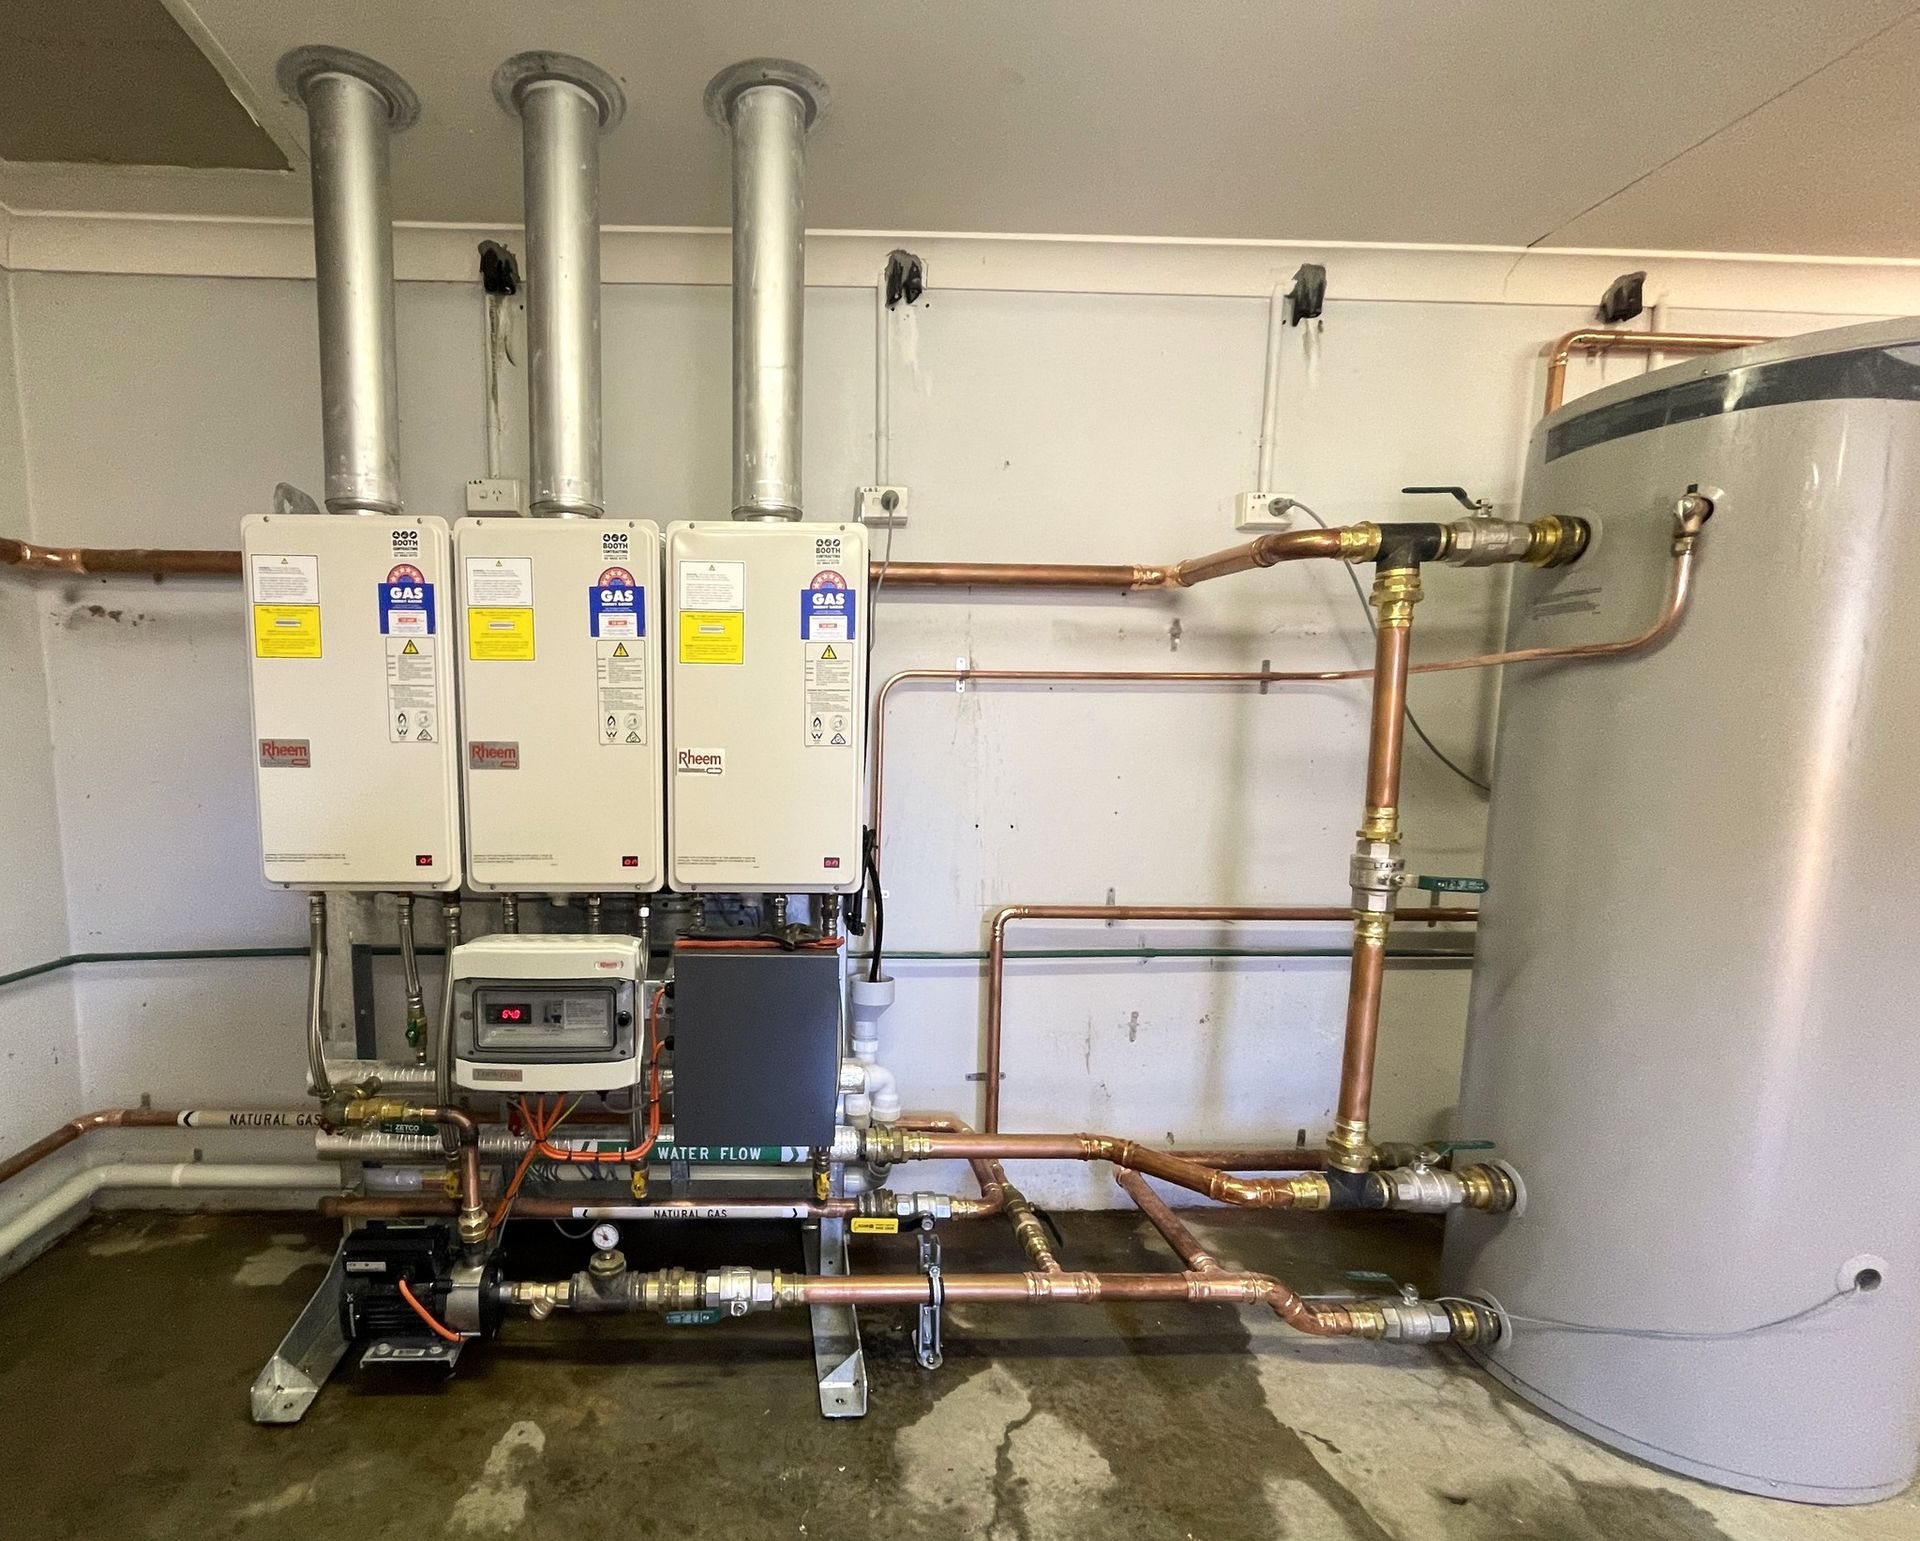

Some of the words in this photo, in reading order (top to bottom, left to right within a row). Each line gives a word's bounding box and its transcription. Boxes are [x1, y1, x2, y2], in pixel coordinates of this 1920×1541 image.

[390, 587, 424, 599] GAS
[600, 589, 634, 602] GAS
[812, 592, 845, 606] GAS
[262, 741, 307, 759] Rheem
[472, 743, 516, 762] Rheem
[678, 749, 722, 768] Rheem
[229, 1113, 289, 1126] NATURAL
[296, 1113, 321, 1126] GAS
[395, 1124, 420, 1132] ZETCO
[657, 1146, 709, 1160] WATER
[720, 1147, 761, 1161] FLOW
[654, 1209, 699, 1218] NATURAL
[707, 1209, 727, 1218] GAS
